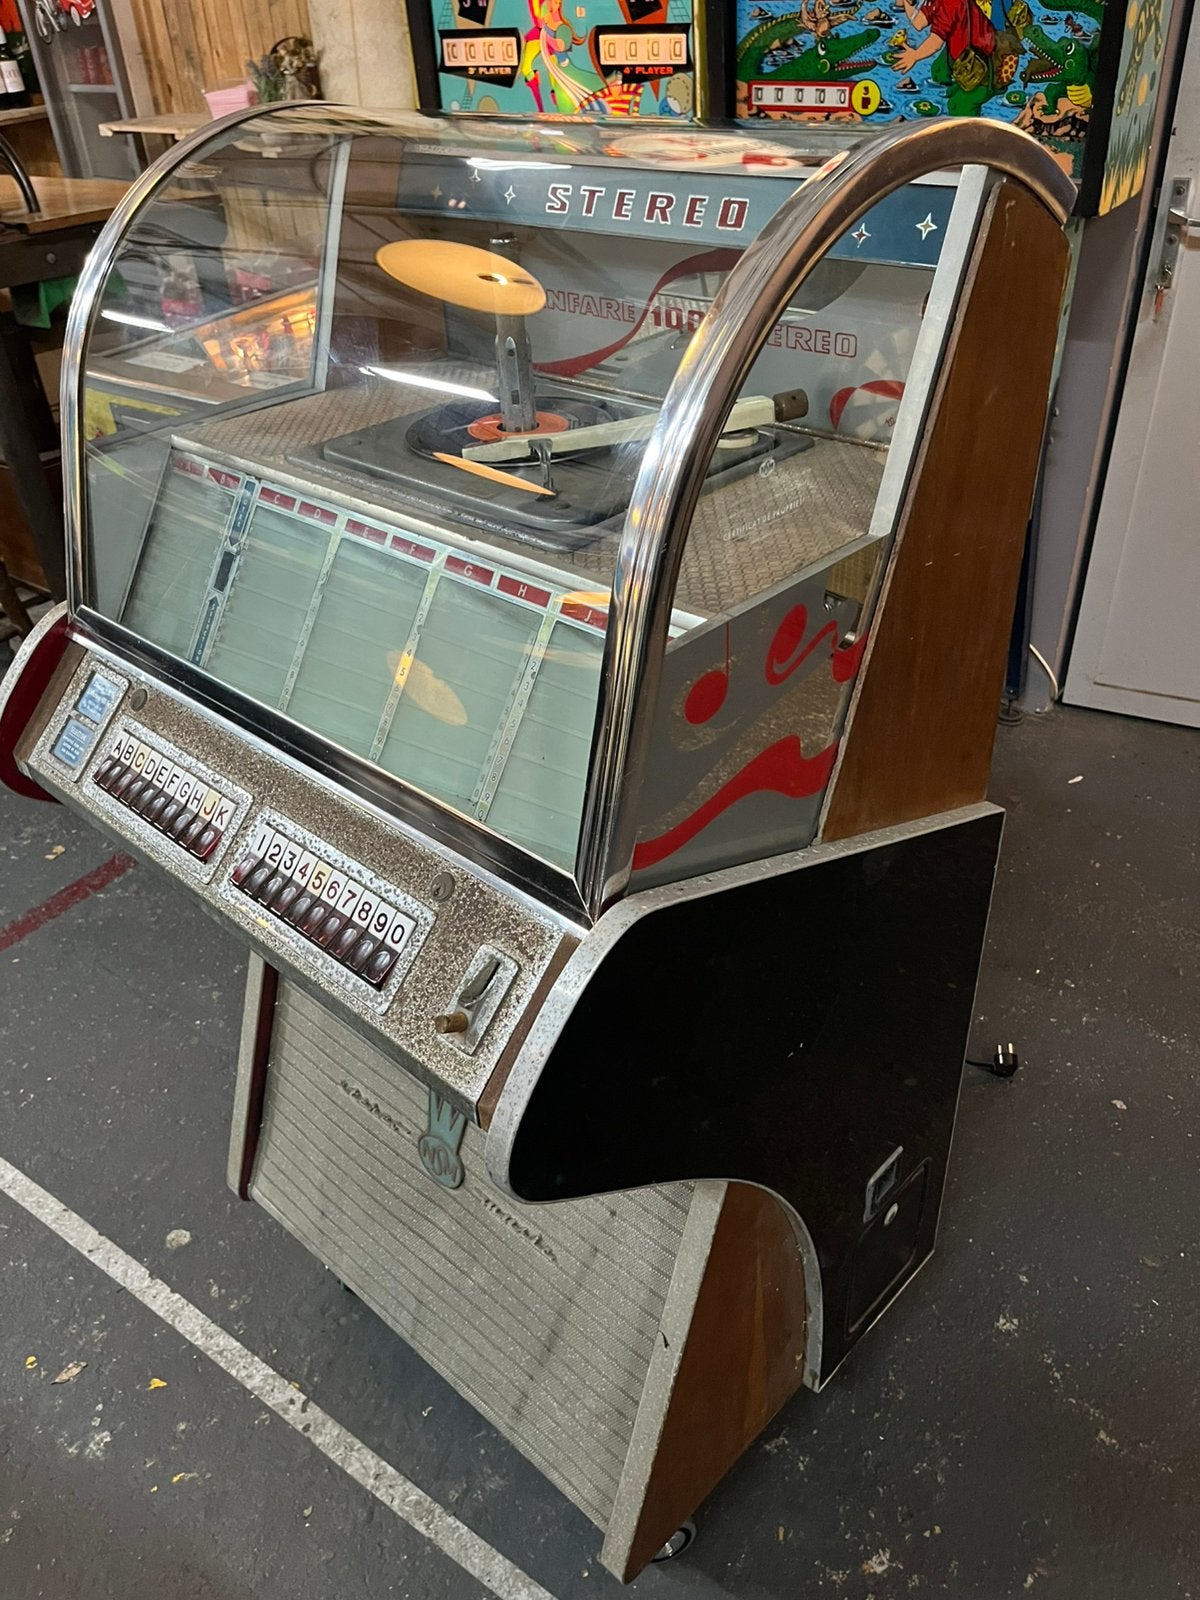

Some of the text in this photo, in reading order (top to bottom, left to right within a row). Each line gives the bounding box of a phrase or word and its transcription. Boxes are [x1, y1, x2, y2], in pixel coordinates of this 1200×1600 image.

[478, 67, 512, 75] PLAYER
[635, 66, 674, 74] PLAYER
[545, 183, 750, 232] STEREO
[543, 289, 635, 323] NFARE
[766, 323, 858, 358] EREO
[274, 494, 280, 504] C
[314, 509, 321, 518] D
[410, 544, 416, 554] F
[463, 565, 473, 576] G
[518, 585, 527, 596] H
[584, 610, 592, 621] J
